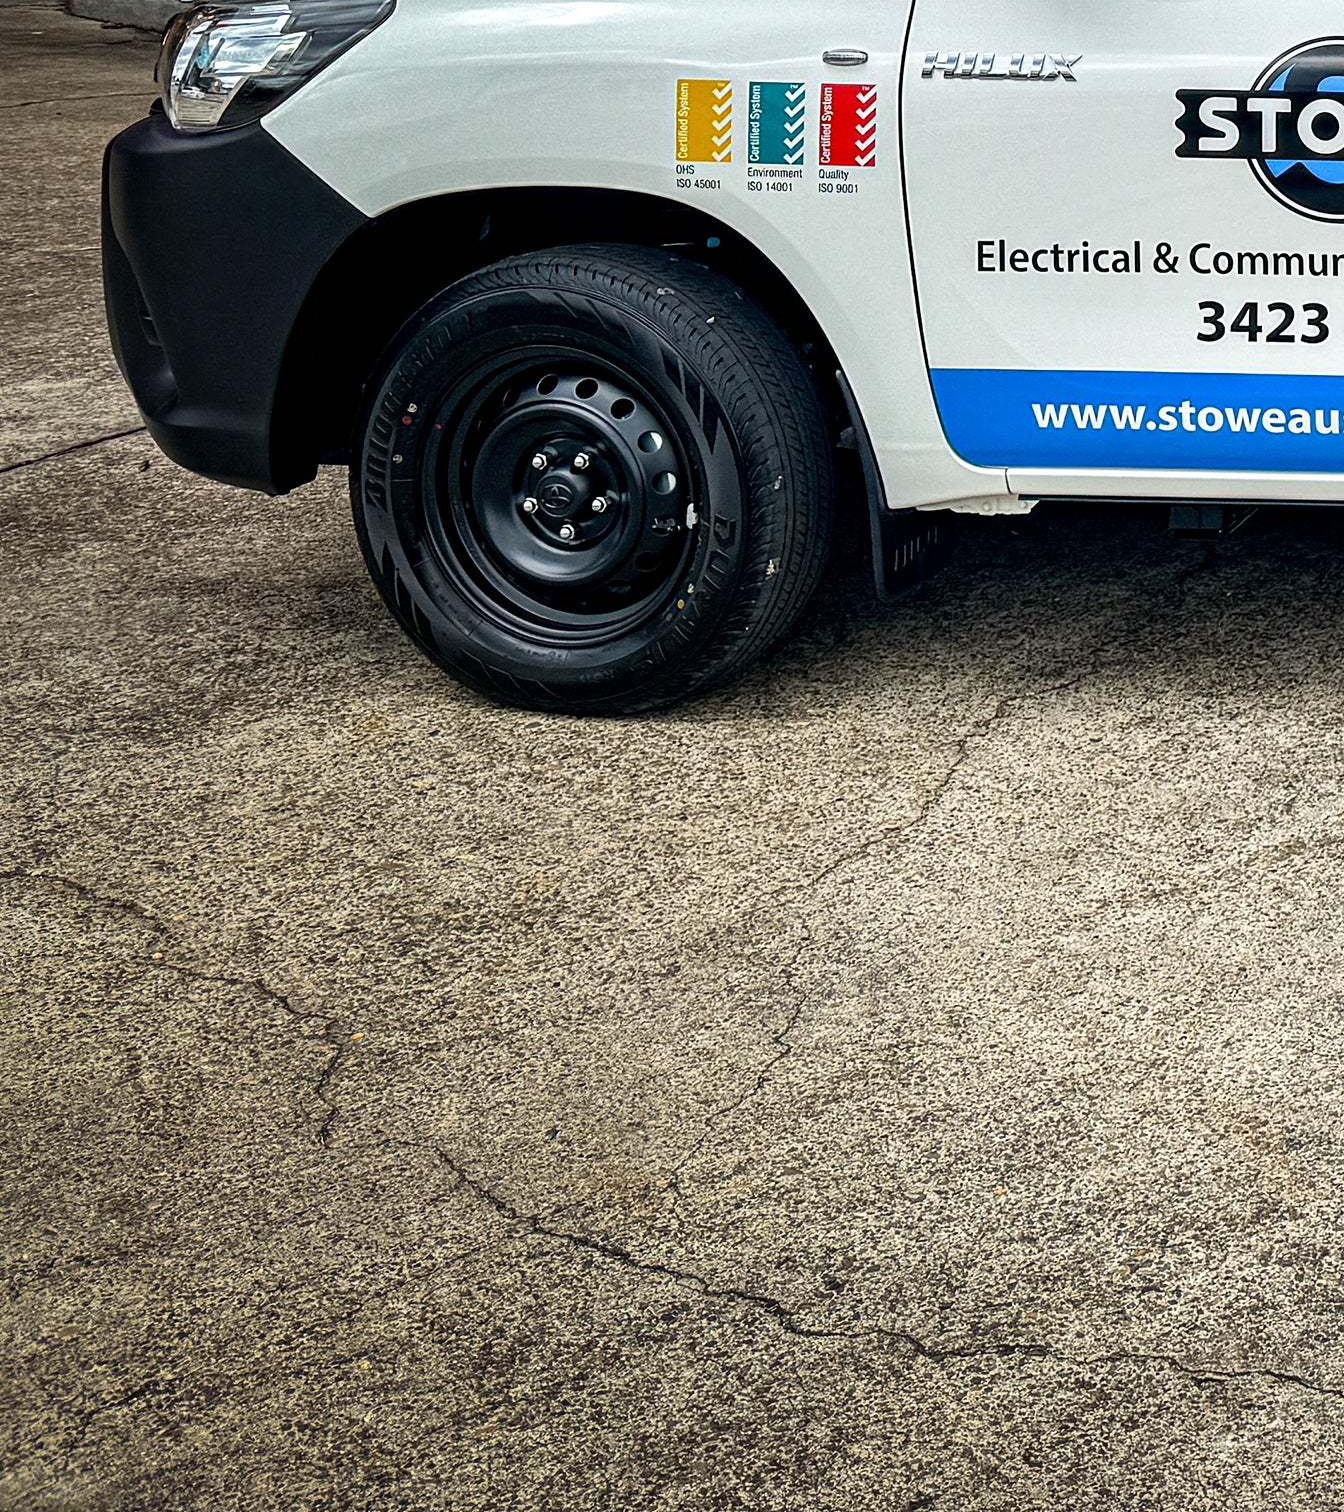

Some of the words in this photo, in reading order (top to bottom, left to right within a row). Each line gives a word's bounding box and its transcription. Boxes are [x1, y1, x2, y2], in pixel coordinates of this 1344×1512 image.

[921, 51, 1084, 82] HILUX
[678, 82, 691, 117] System
[750, 84, 763, 120] System
[821, 87, 834, 122] System
[677, 119, 689, 159] Certified
[749, 121, 760, 161] Certified
[820, 123, 831, 163] Certified
[676, 164, 695, 175] OHS
[677, 178, 692, 189] ISO
[694, 179, 721, 190] 45001
[747, 167, 803, 179] Environment
[747, 181, 762, 191] ISO
[766, 182, 793, 192] 14001
[818, 169, 849, 181] Quality
[818, 183, 834, 193] ISO
[836, 183, 858, 194] 9001
[976, 241, 1142, 275] Electrical
[1153, 243, 1179, 275] &
[1196, 302, 1330, 345] 3423
